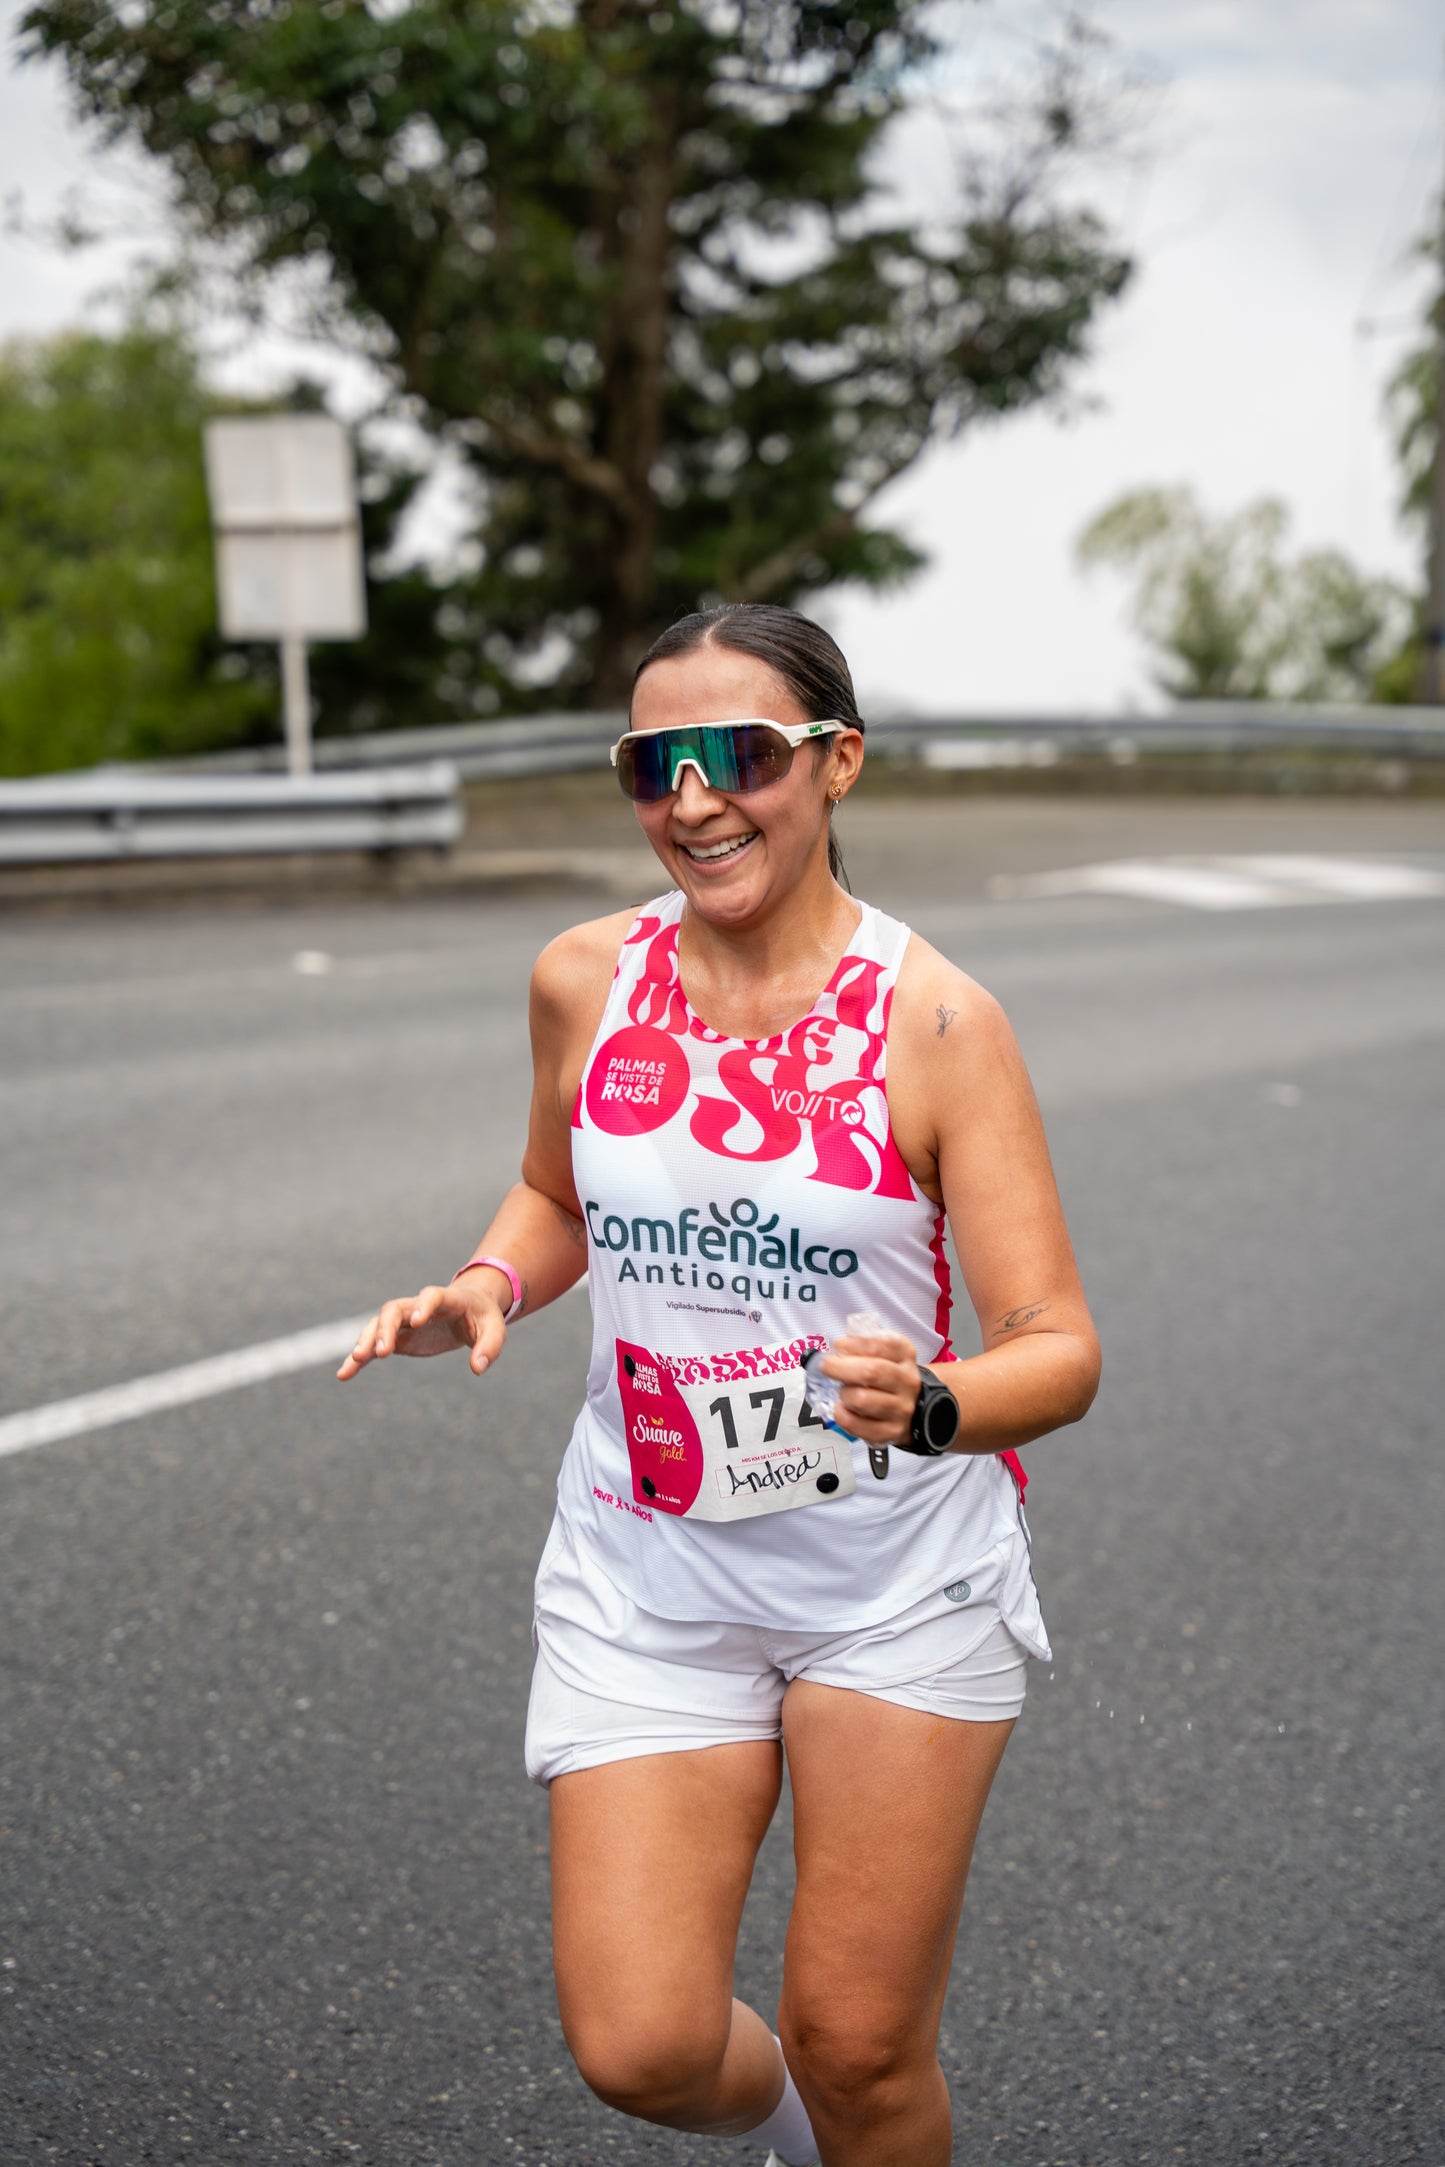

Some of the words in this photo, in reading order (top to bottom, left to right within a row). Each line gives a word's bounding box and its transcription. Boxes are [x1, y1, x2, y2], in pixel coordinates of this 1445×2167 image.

[607, 1057, 667, 1075] PALMAS
[605, 1071, 618, 1082] SE
[619, 1073, 646, 1084] VISTE
[648, 1075, 664, 1086] DE
[601, 1082, 660, 1105] ROSA
[585, 1199, 859, 1278] Comfenalco
[618, 1257, 817, 1303] Antioquia
[666, 1301, 695, 1311] Vigilado
[695, 1304, 746, 1317] Supersubsidio
[635, 1362, 658, 1377] ALMAS
[632, 1377, 662, 1396] ROSA
[632, 1414, 685, 1447] Suave
[659, 1445, 686, 1464] gold
[725, 1452, 821, 1495] Andrea
[631, 1505, 653, 1523] AÑOS
